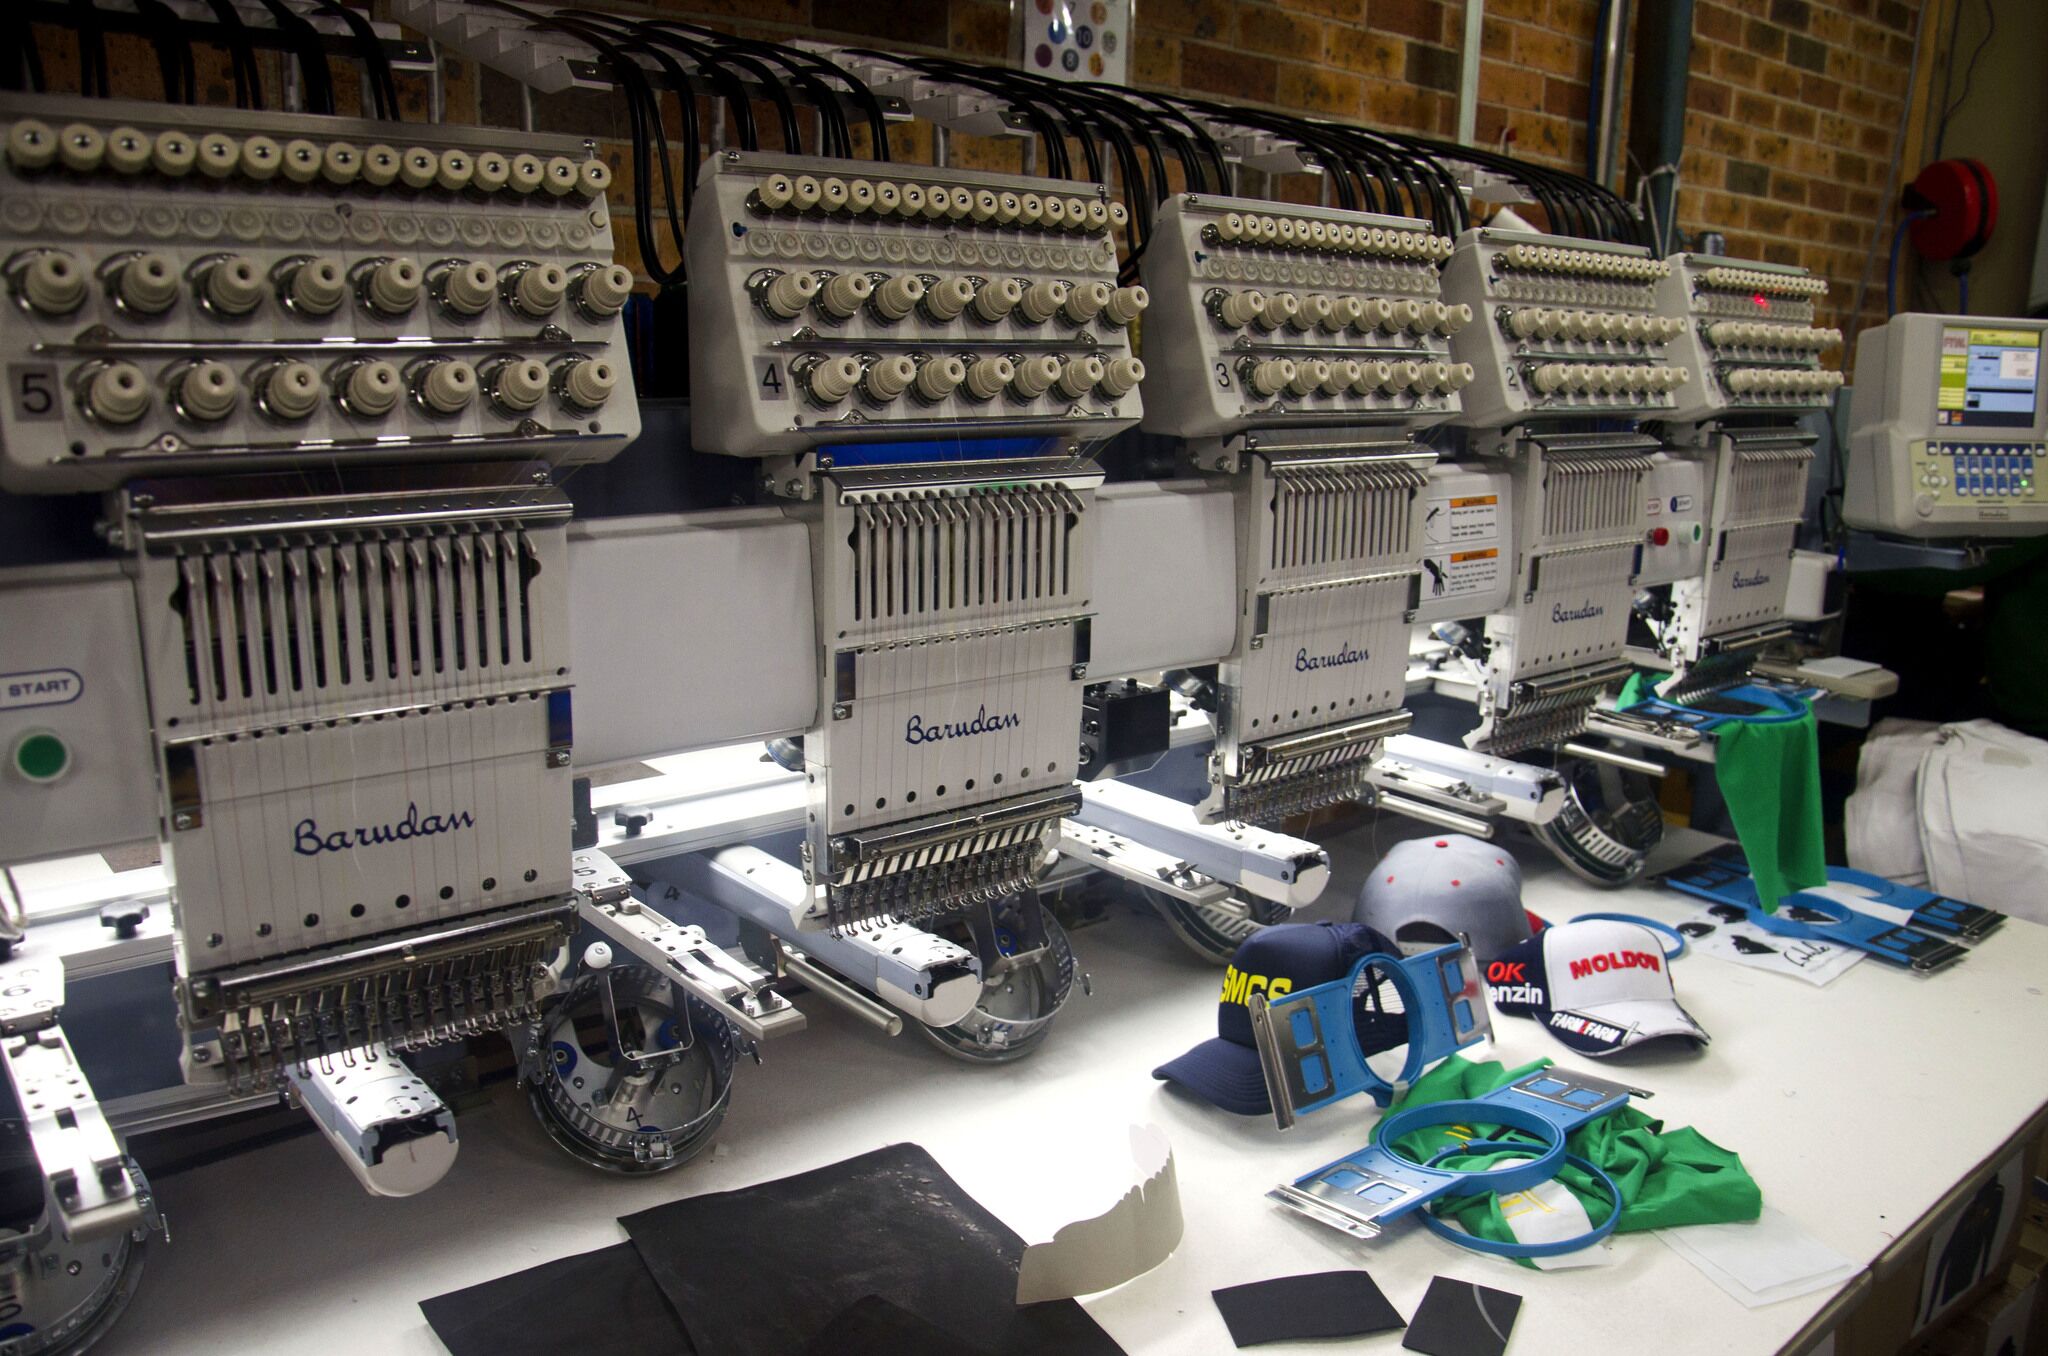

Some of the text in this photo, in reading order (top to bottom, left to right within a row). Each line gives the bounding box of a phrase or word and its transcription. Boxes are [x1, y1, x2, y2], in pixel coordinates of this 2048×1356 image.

[1076, 29, 1091, 45] 10
[1066, 53, 1075, 68] 8
[762, 363, 782, 394] 4
[1216, 362, 1231, 388] 3
[1505, 366, 1517, 387] 2
[22, 373, 53, 414] 5
[1552, 597, 1604, 623] Barudan
[1295, 641, 1369, 672] Barudan
[8, 678, 71, 697] START
[905, 703, 1020, 745] Barudan
[294, 800, 475, 856] Barudan
[573, 866, 597, 877] 5
[663, 885, 681, 901] 4
[1487, 961, 1526, 983] OK
[625, 1105, 644, 1128] 4
